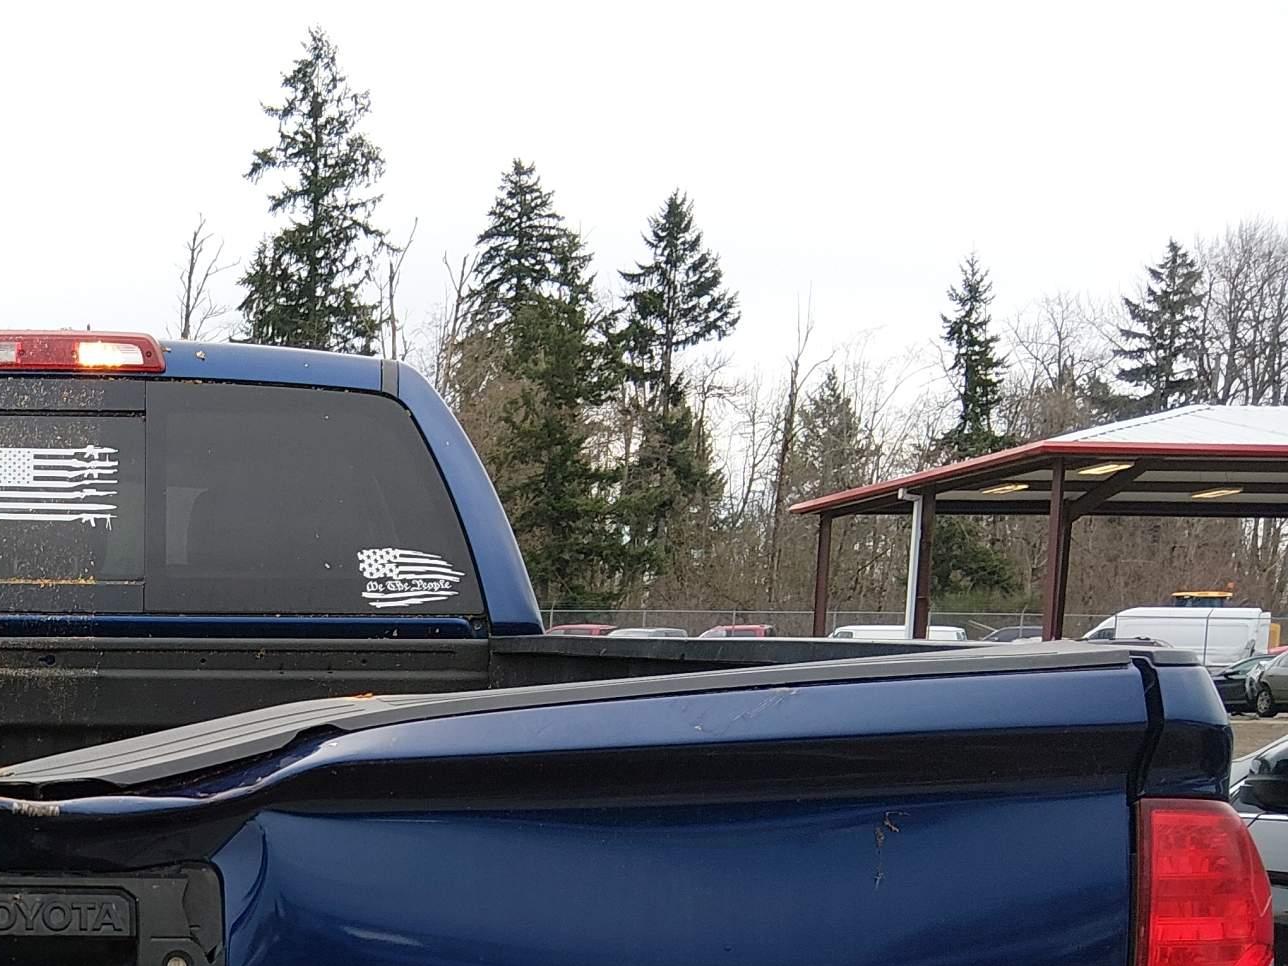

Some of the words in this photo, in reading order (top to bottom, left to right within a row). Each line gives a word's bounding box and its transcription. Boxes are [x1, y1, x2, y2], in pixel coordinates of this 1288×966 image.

[366, 580, 385, 592] We
[386, 580, 410, 592] The
[411, 580, 453, 592] People
